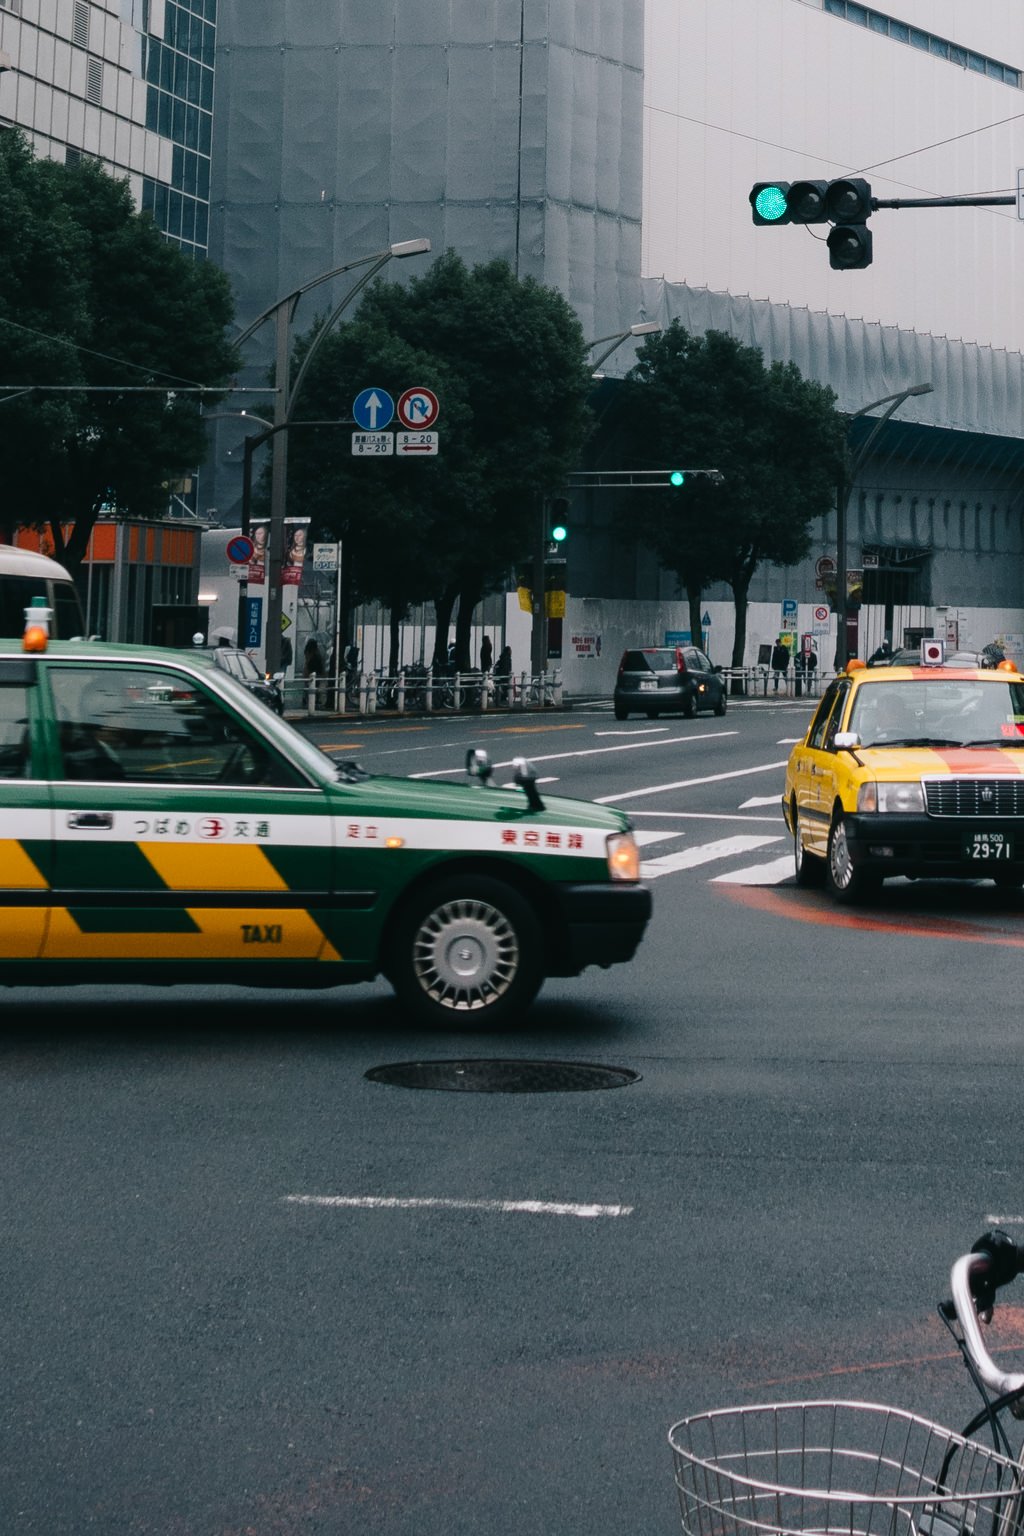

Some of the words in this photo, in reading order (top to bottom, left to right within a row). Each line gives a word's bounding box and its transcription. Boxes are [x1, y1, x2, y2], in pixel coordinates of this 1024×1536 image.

[783, 601, 796, 616] P
[134, 821, 190, 835] つばめ
[234, 821, 271, 838] 交通
[347, 824, 378, 839] 足立
[502, 830, 583, 849] 東京無線
[990, 834, 1003, 842] 500
[973, 843, 1010, 858] 29-71
[241, 925, 282, 943] TAXI
